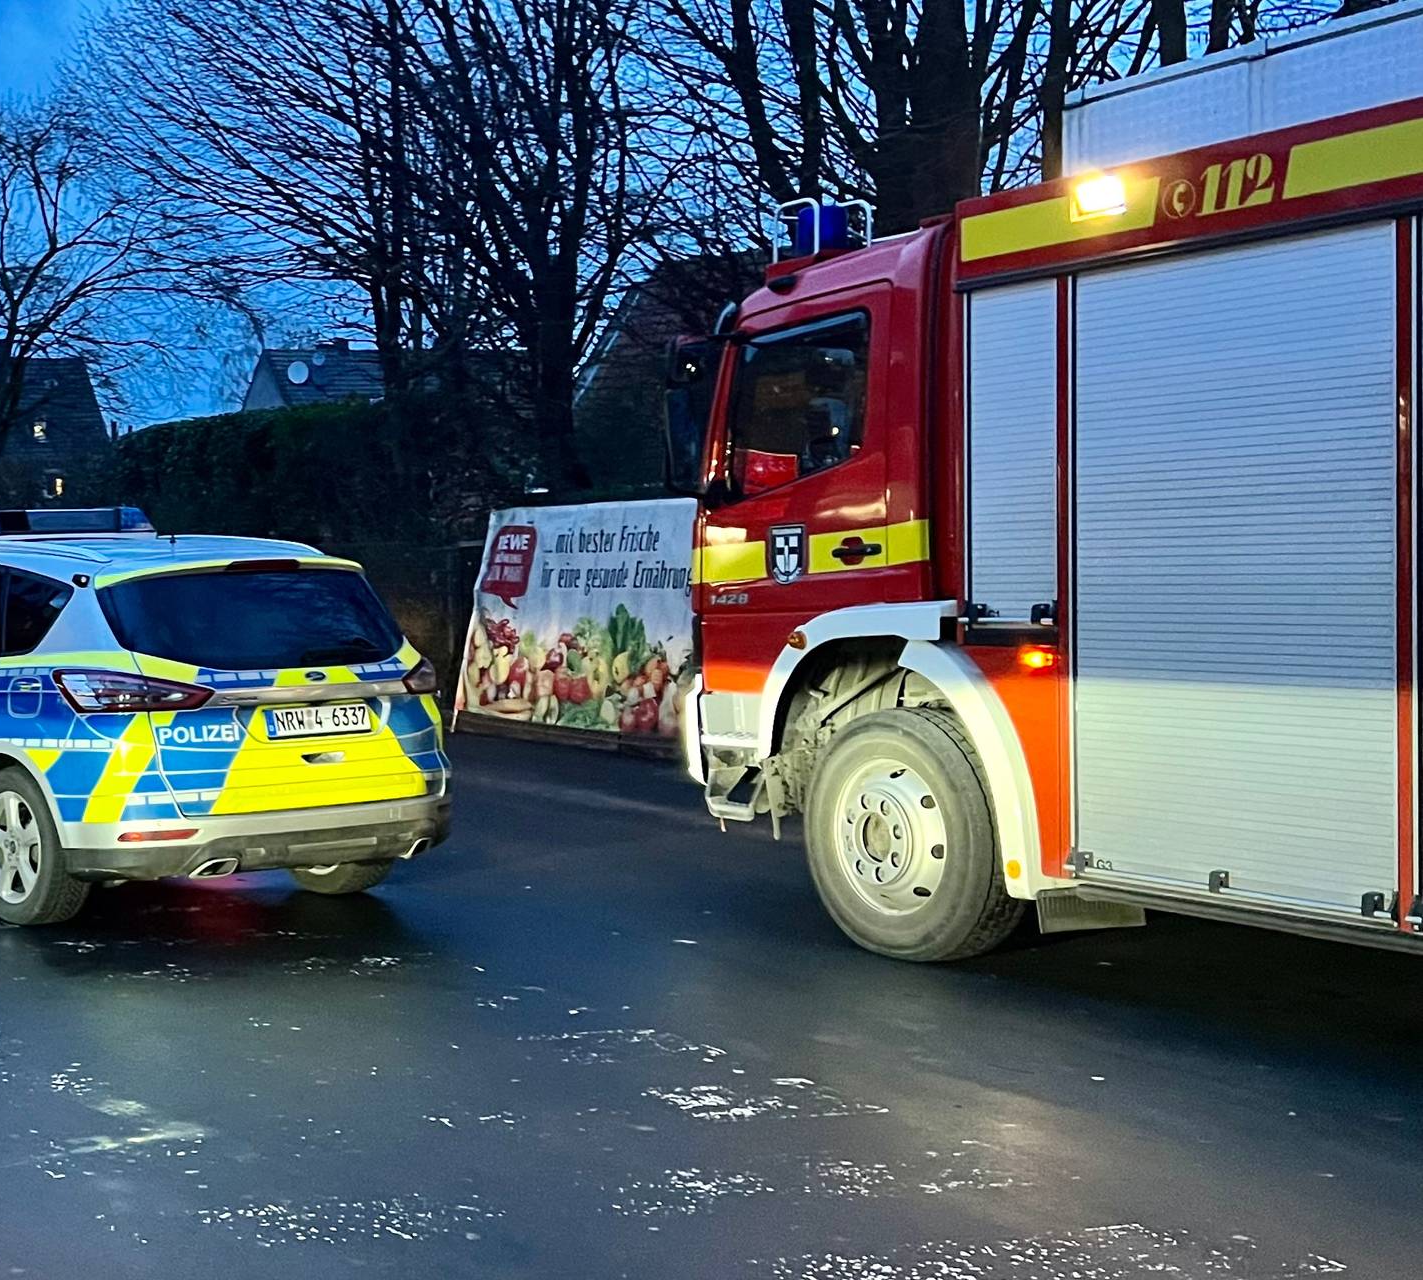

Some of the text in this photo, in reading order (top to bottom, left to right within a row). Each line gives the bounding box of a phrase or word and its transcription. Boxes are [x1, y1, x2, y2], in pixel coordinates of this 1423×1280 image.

[1195, 153, 1275, 217] 112
[578, 526, 617, 553] bester
[618, 523, 660, 552] Frische
[557, 562, 581, 588] eine
[584, 561, 629, 596] gesunde
[633, 560, 692, 597] Ernährung
[710, 593, 748, 605] 1428
[275, 711, 305, 731] NRW
[159, 723, 240, 744] POLIZEI
[1097, 859, 1113, 870] G3
